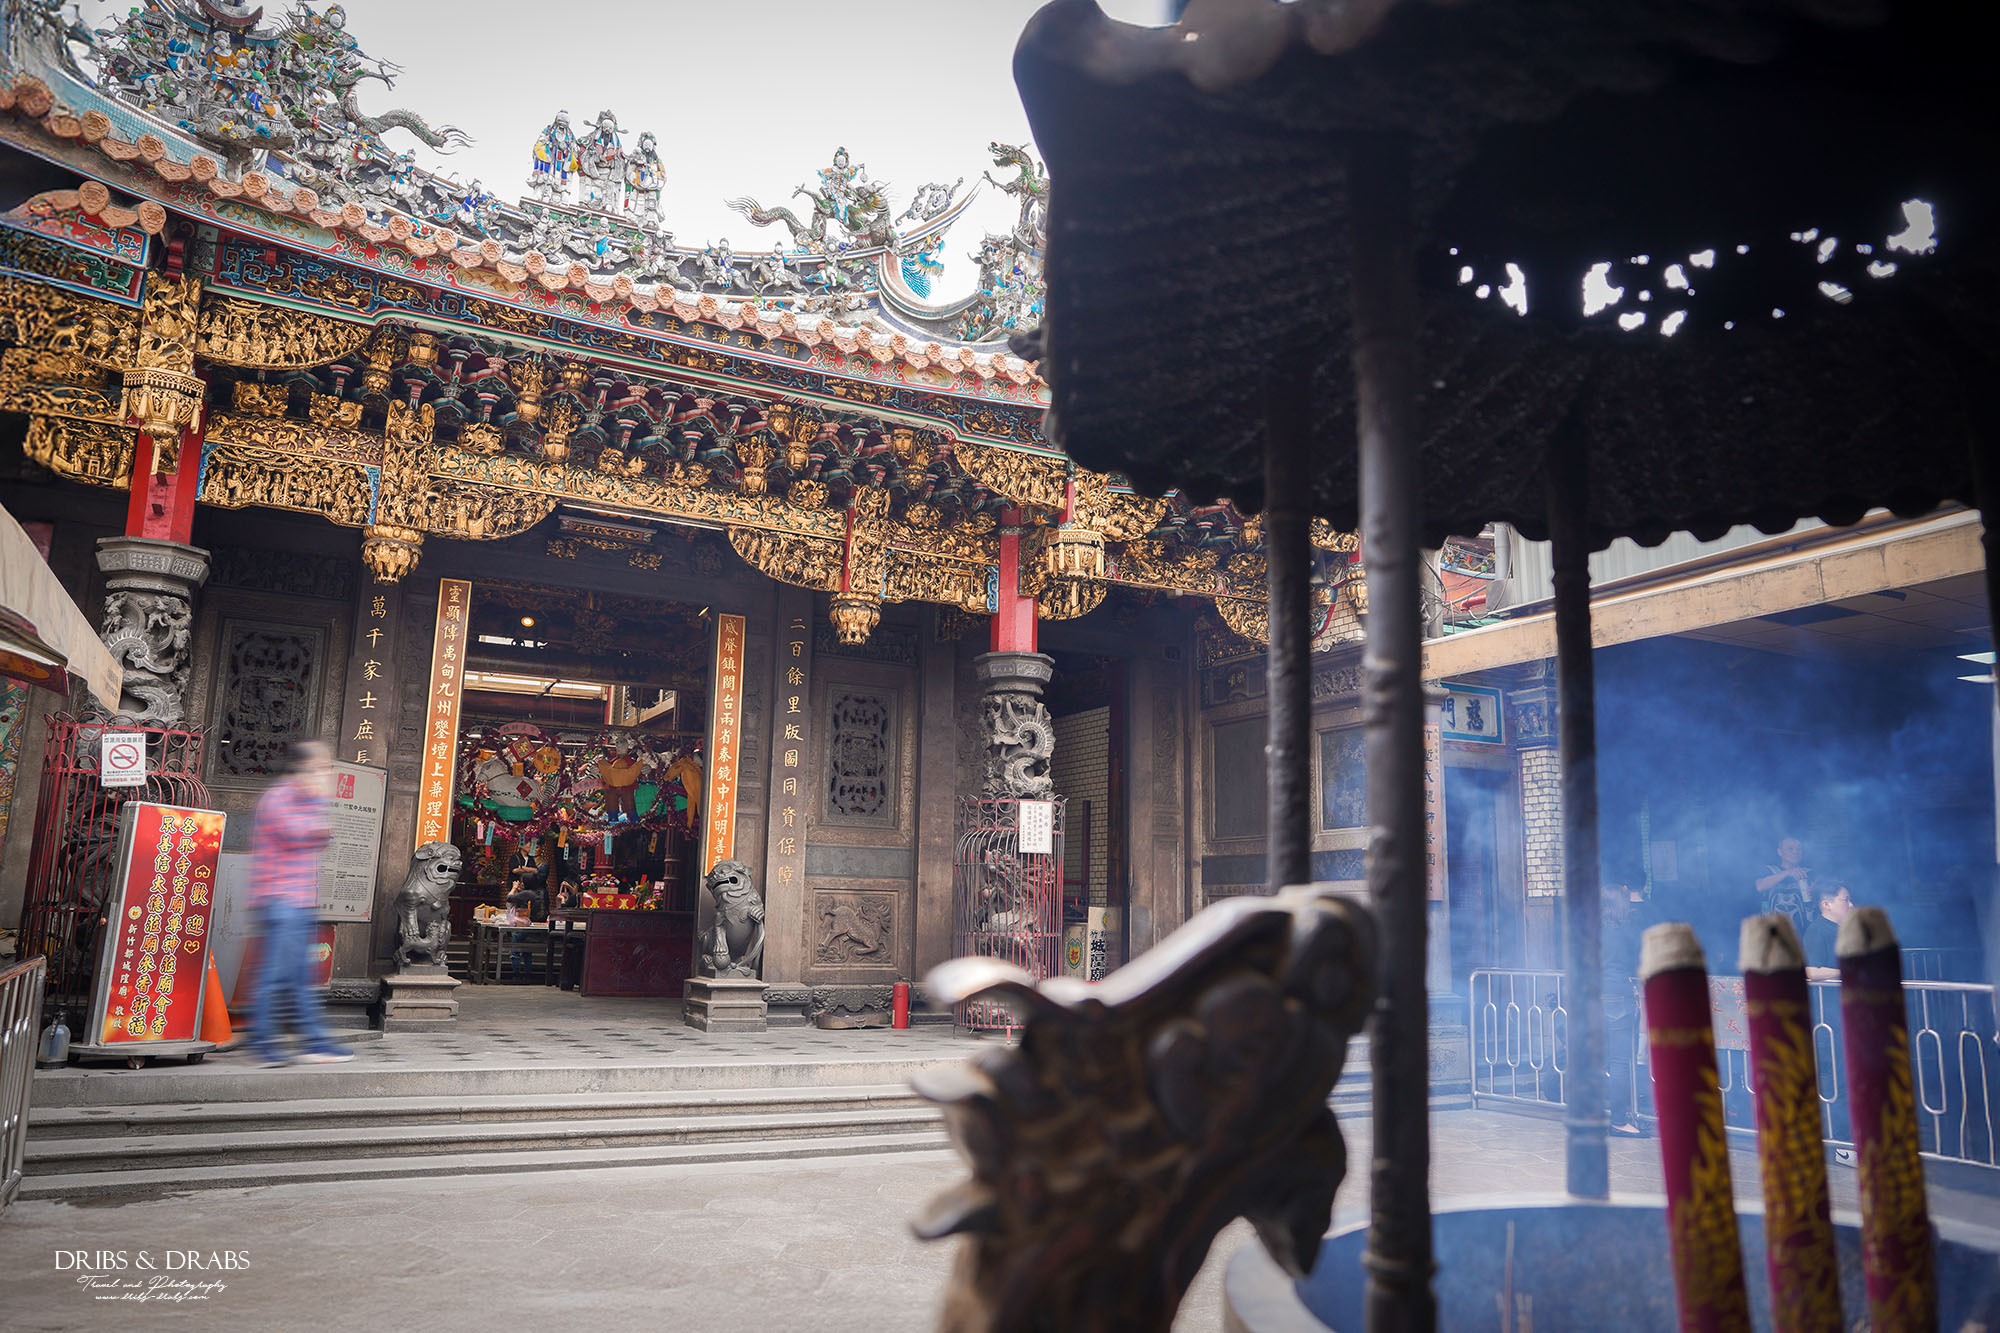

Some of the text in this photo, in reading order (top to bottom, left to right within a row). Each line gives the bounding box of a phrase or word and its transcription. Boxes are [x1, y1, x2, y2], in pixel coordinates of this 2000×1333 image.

[777, 617, 806, 887] 二百餘里版圖同資保障
[185, 882, 209, 937] 歡迎
[118, 923, 138, 997] 新竹都城隍廟
